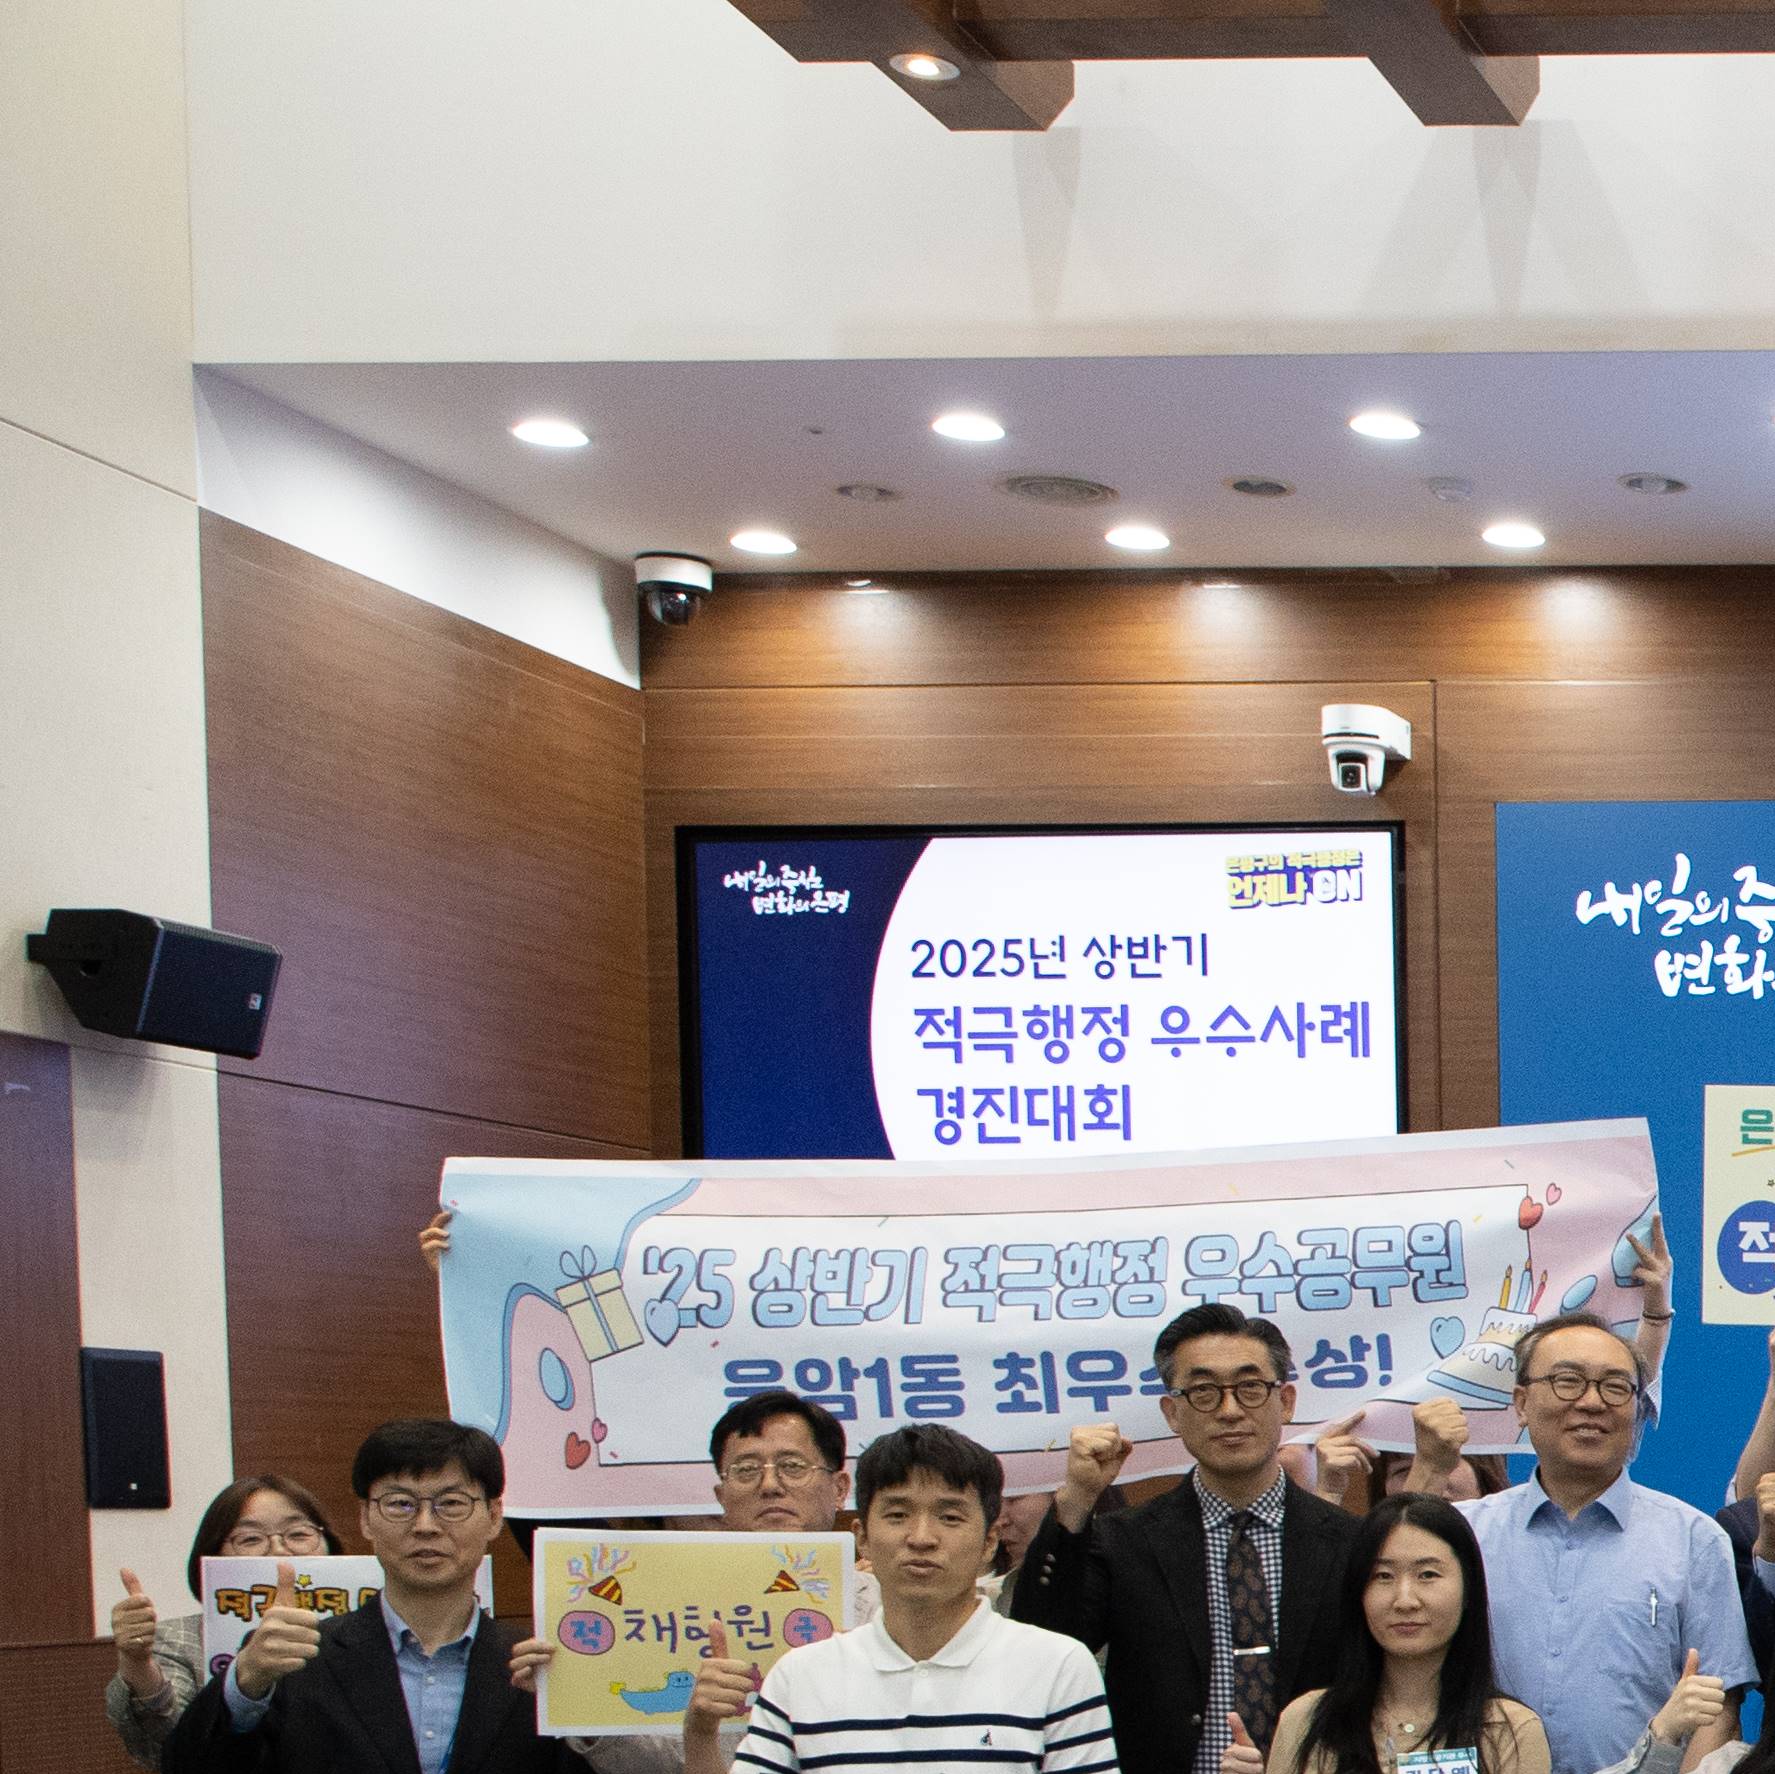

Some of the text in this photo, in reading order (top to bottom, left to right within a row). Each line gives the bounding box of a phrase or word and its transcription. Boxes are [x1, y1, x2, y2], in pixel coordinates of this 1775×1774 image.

[1227, 868, 1362, 908] 언제나 ON
[1575, 853, 1730, 936] 내일의
[909, 933, 1208, 980] 2025년 상반기
[913, 1001, 1372, 1066] 적극행정 우수사례
[915, 1084, 1133, 1147] 경진대회
[749, 1245, 928, 1329] 상반기
[942, 1235, 1169, 1323] 적극행정
[1182, 1219, 1470, 1313] 우수공무원
